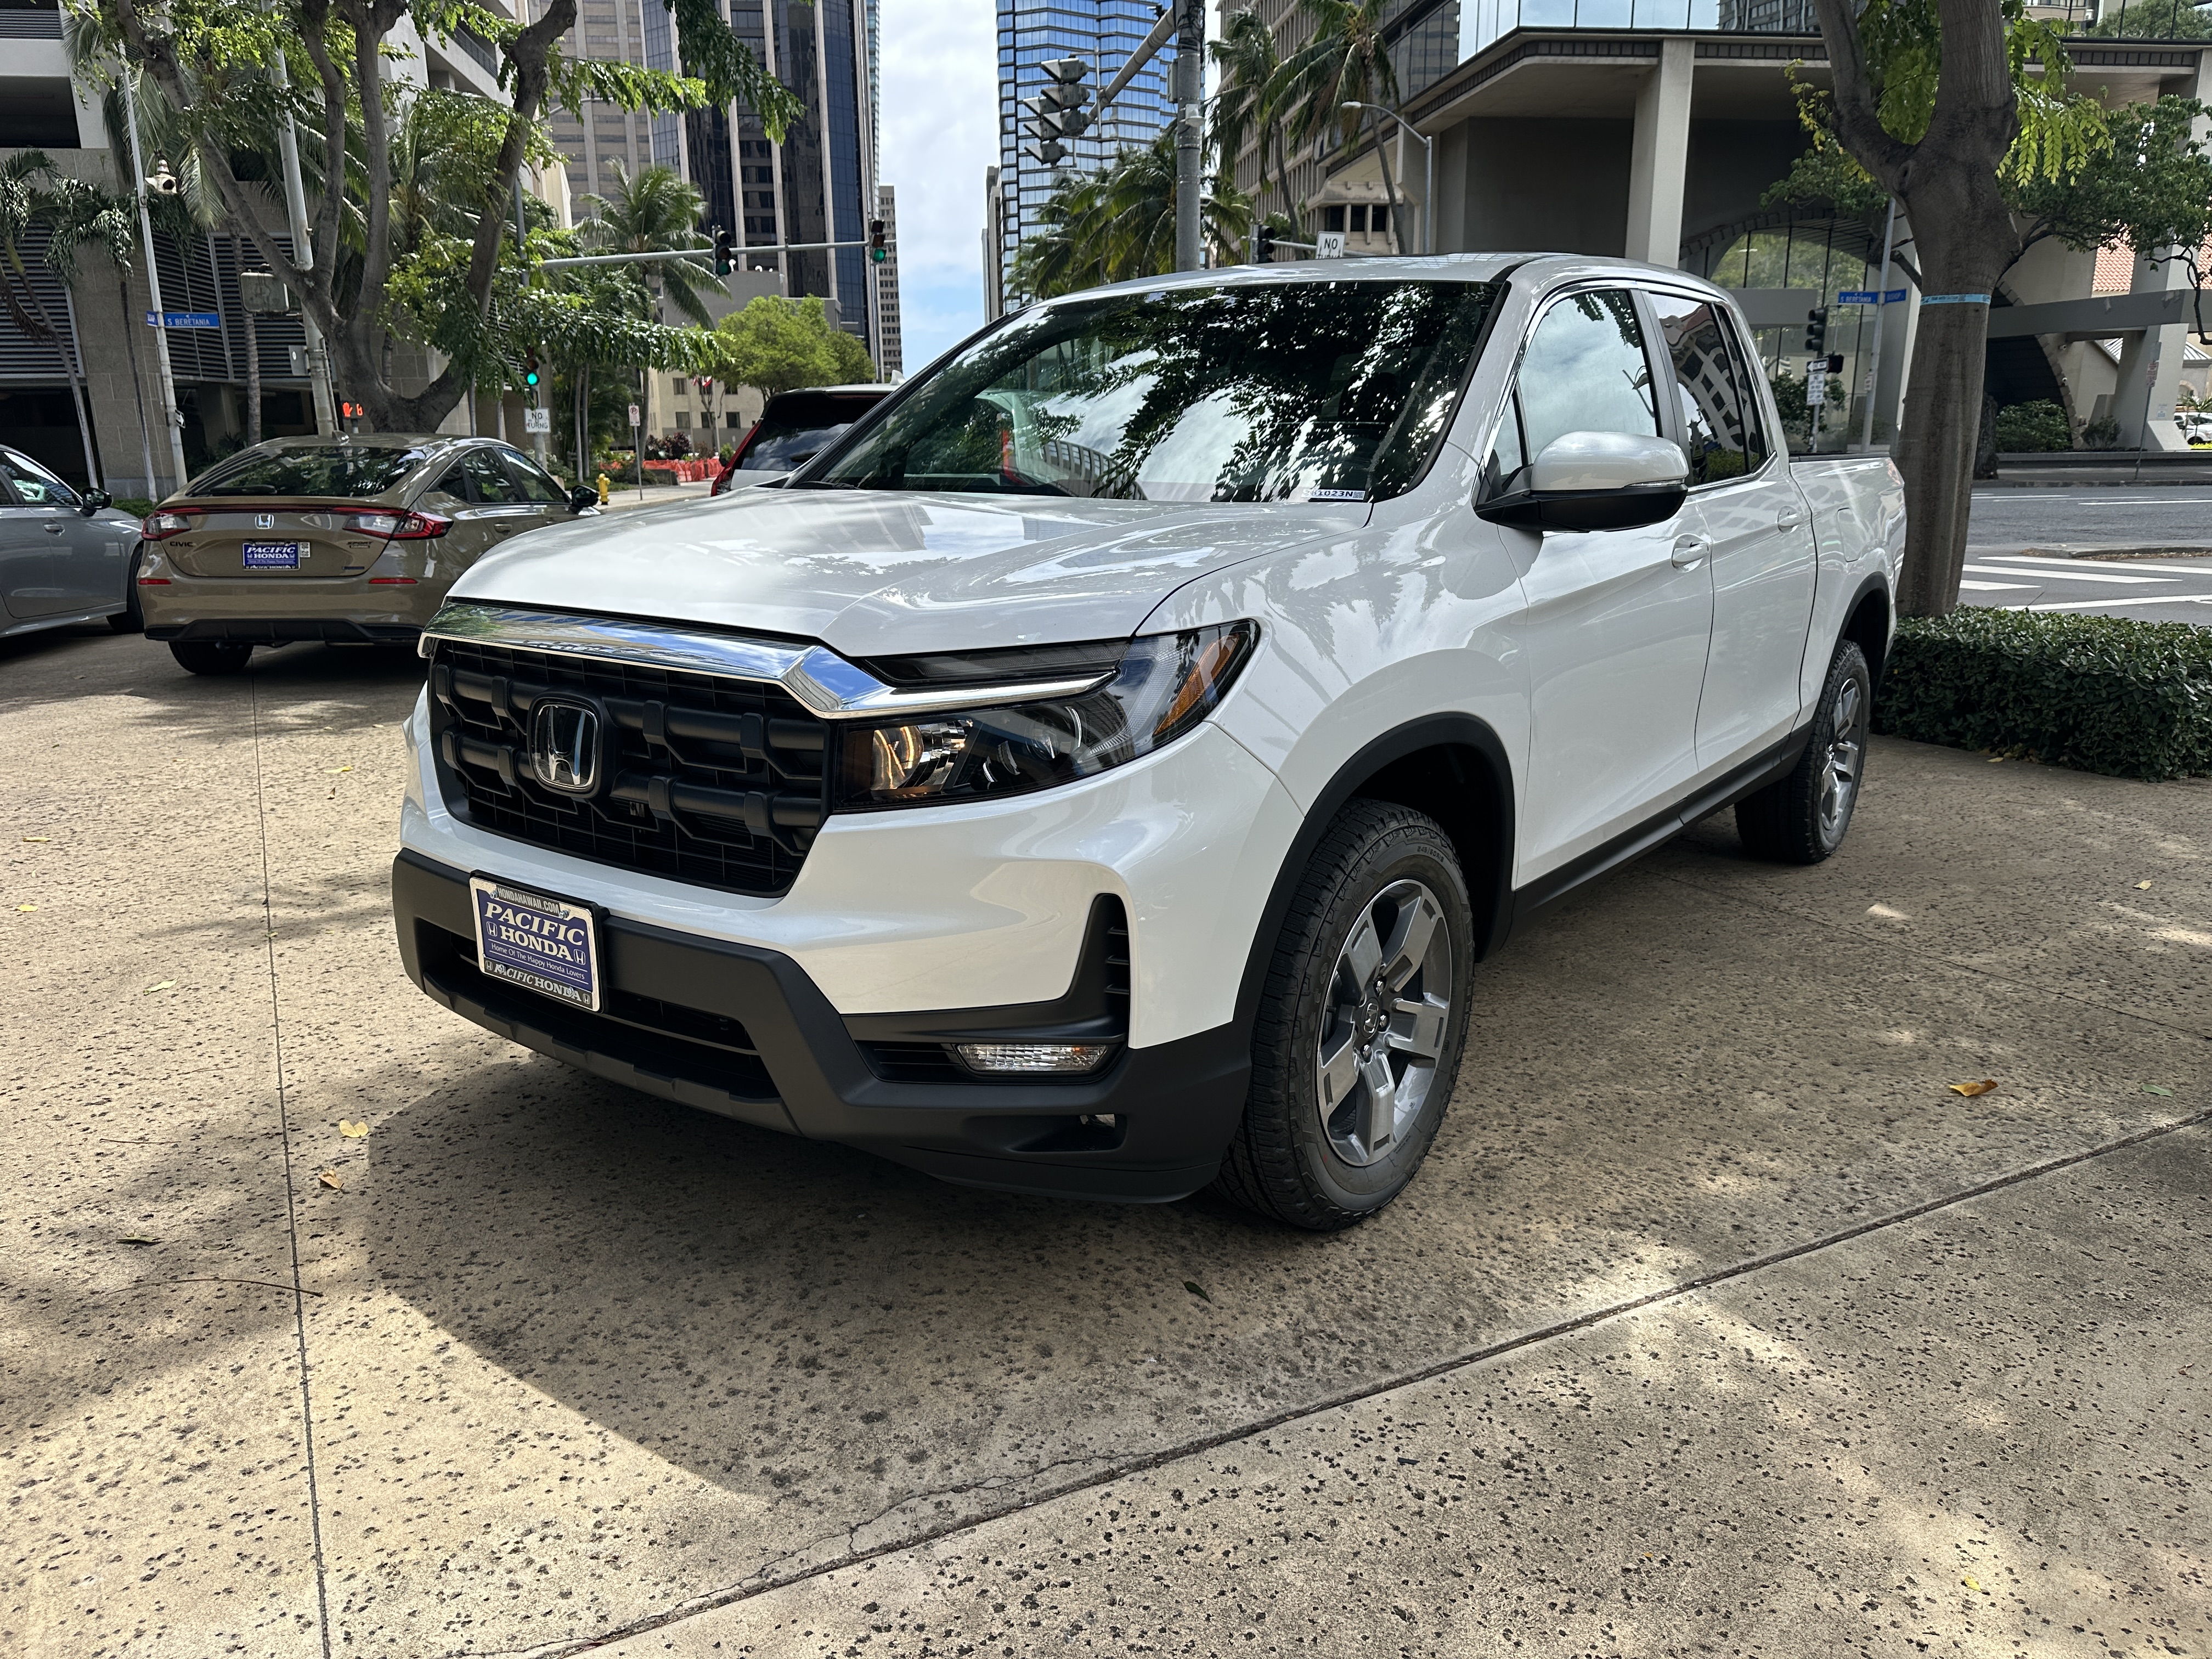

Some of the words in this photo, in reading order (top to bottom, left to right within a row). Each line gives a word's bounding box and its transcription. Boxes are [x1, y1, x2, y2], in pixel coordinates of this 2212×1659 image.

[1324, 238, 1338, 250] NO
[498, 887, 559, 914] HONDAHAWAII.COM
[484, 901, 585, 946] PACIFIC
[491, 943, 507, 954] Home
[516, 951, 527, 960] The
[527, 955, 545, 968] Happy
[546, 961, 565, 973] Honda
[566, 968, 585, 980] Lovers
[499, 925, 574, 962] HONDA
